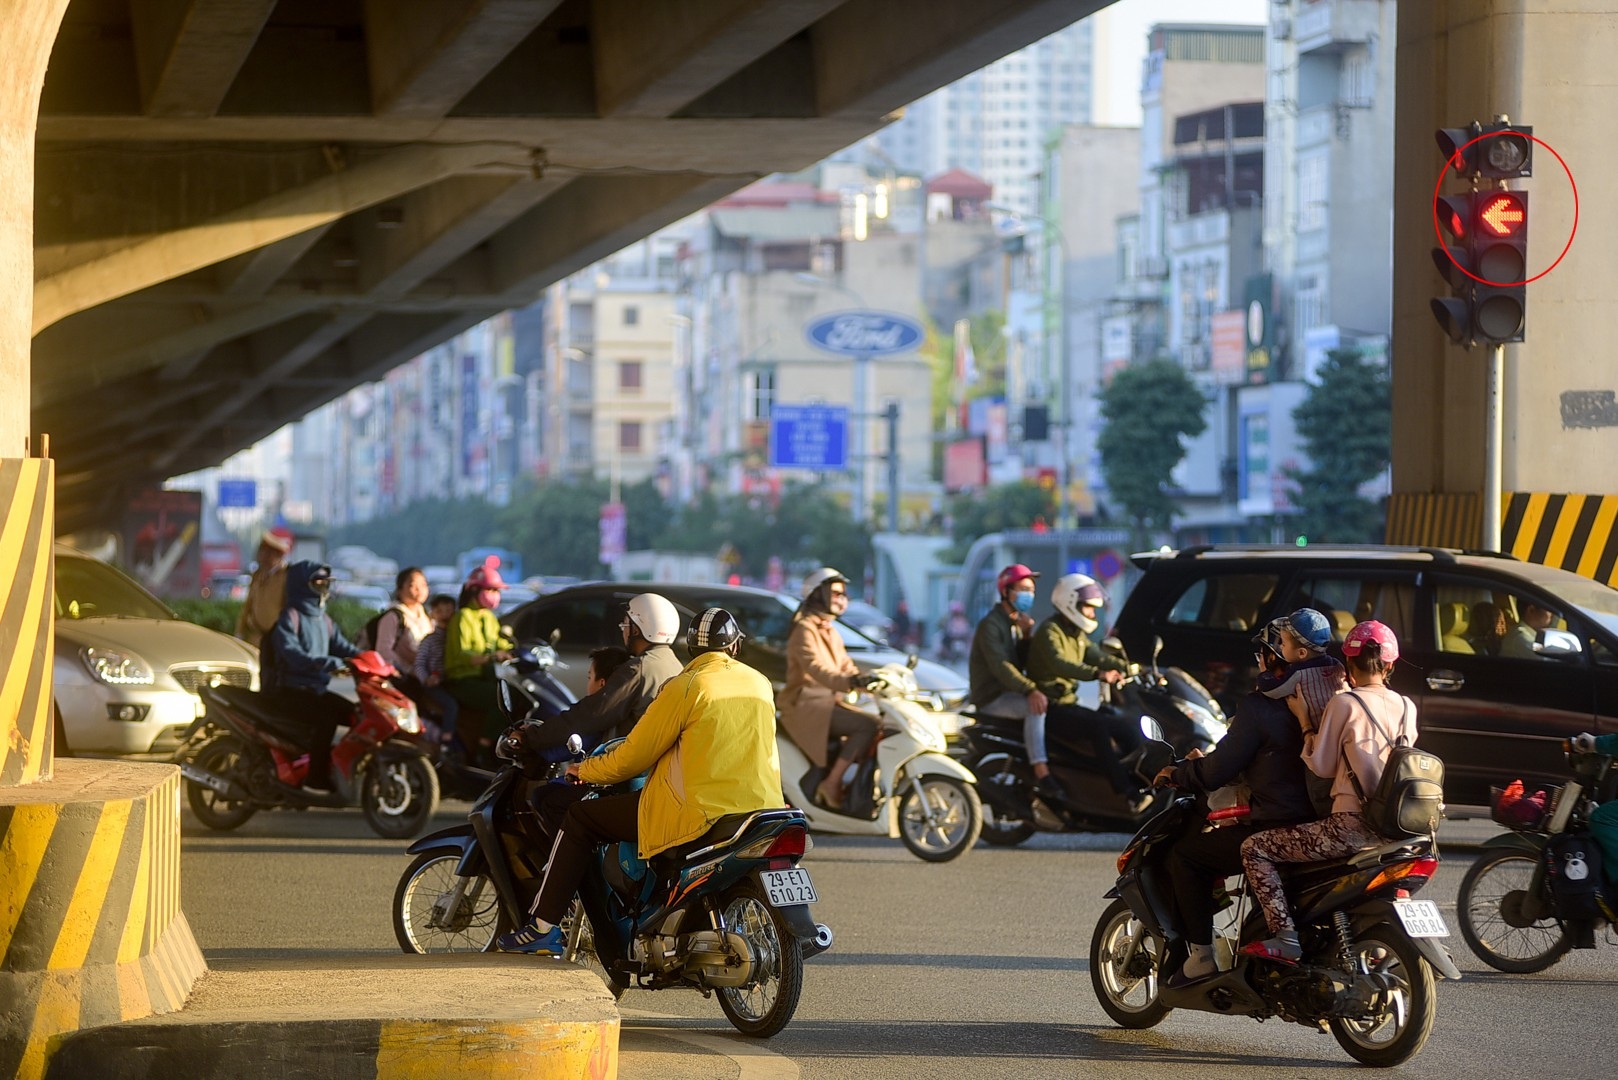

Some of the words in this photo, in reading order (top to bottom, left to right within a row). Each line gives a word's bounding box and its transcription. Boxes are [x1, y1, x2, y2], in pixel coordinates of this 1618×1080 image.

[826, 315, 904, 350] Ford
[767, 871, 804, 887] 29-E1
[769, 886, 814, 904] 610.23
[1400, 904, 1434, 917] 29-G1
[1405, 919, 1445, 934] 068.84
